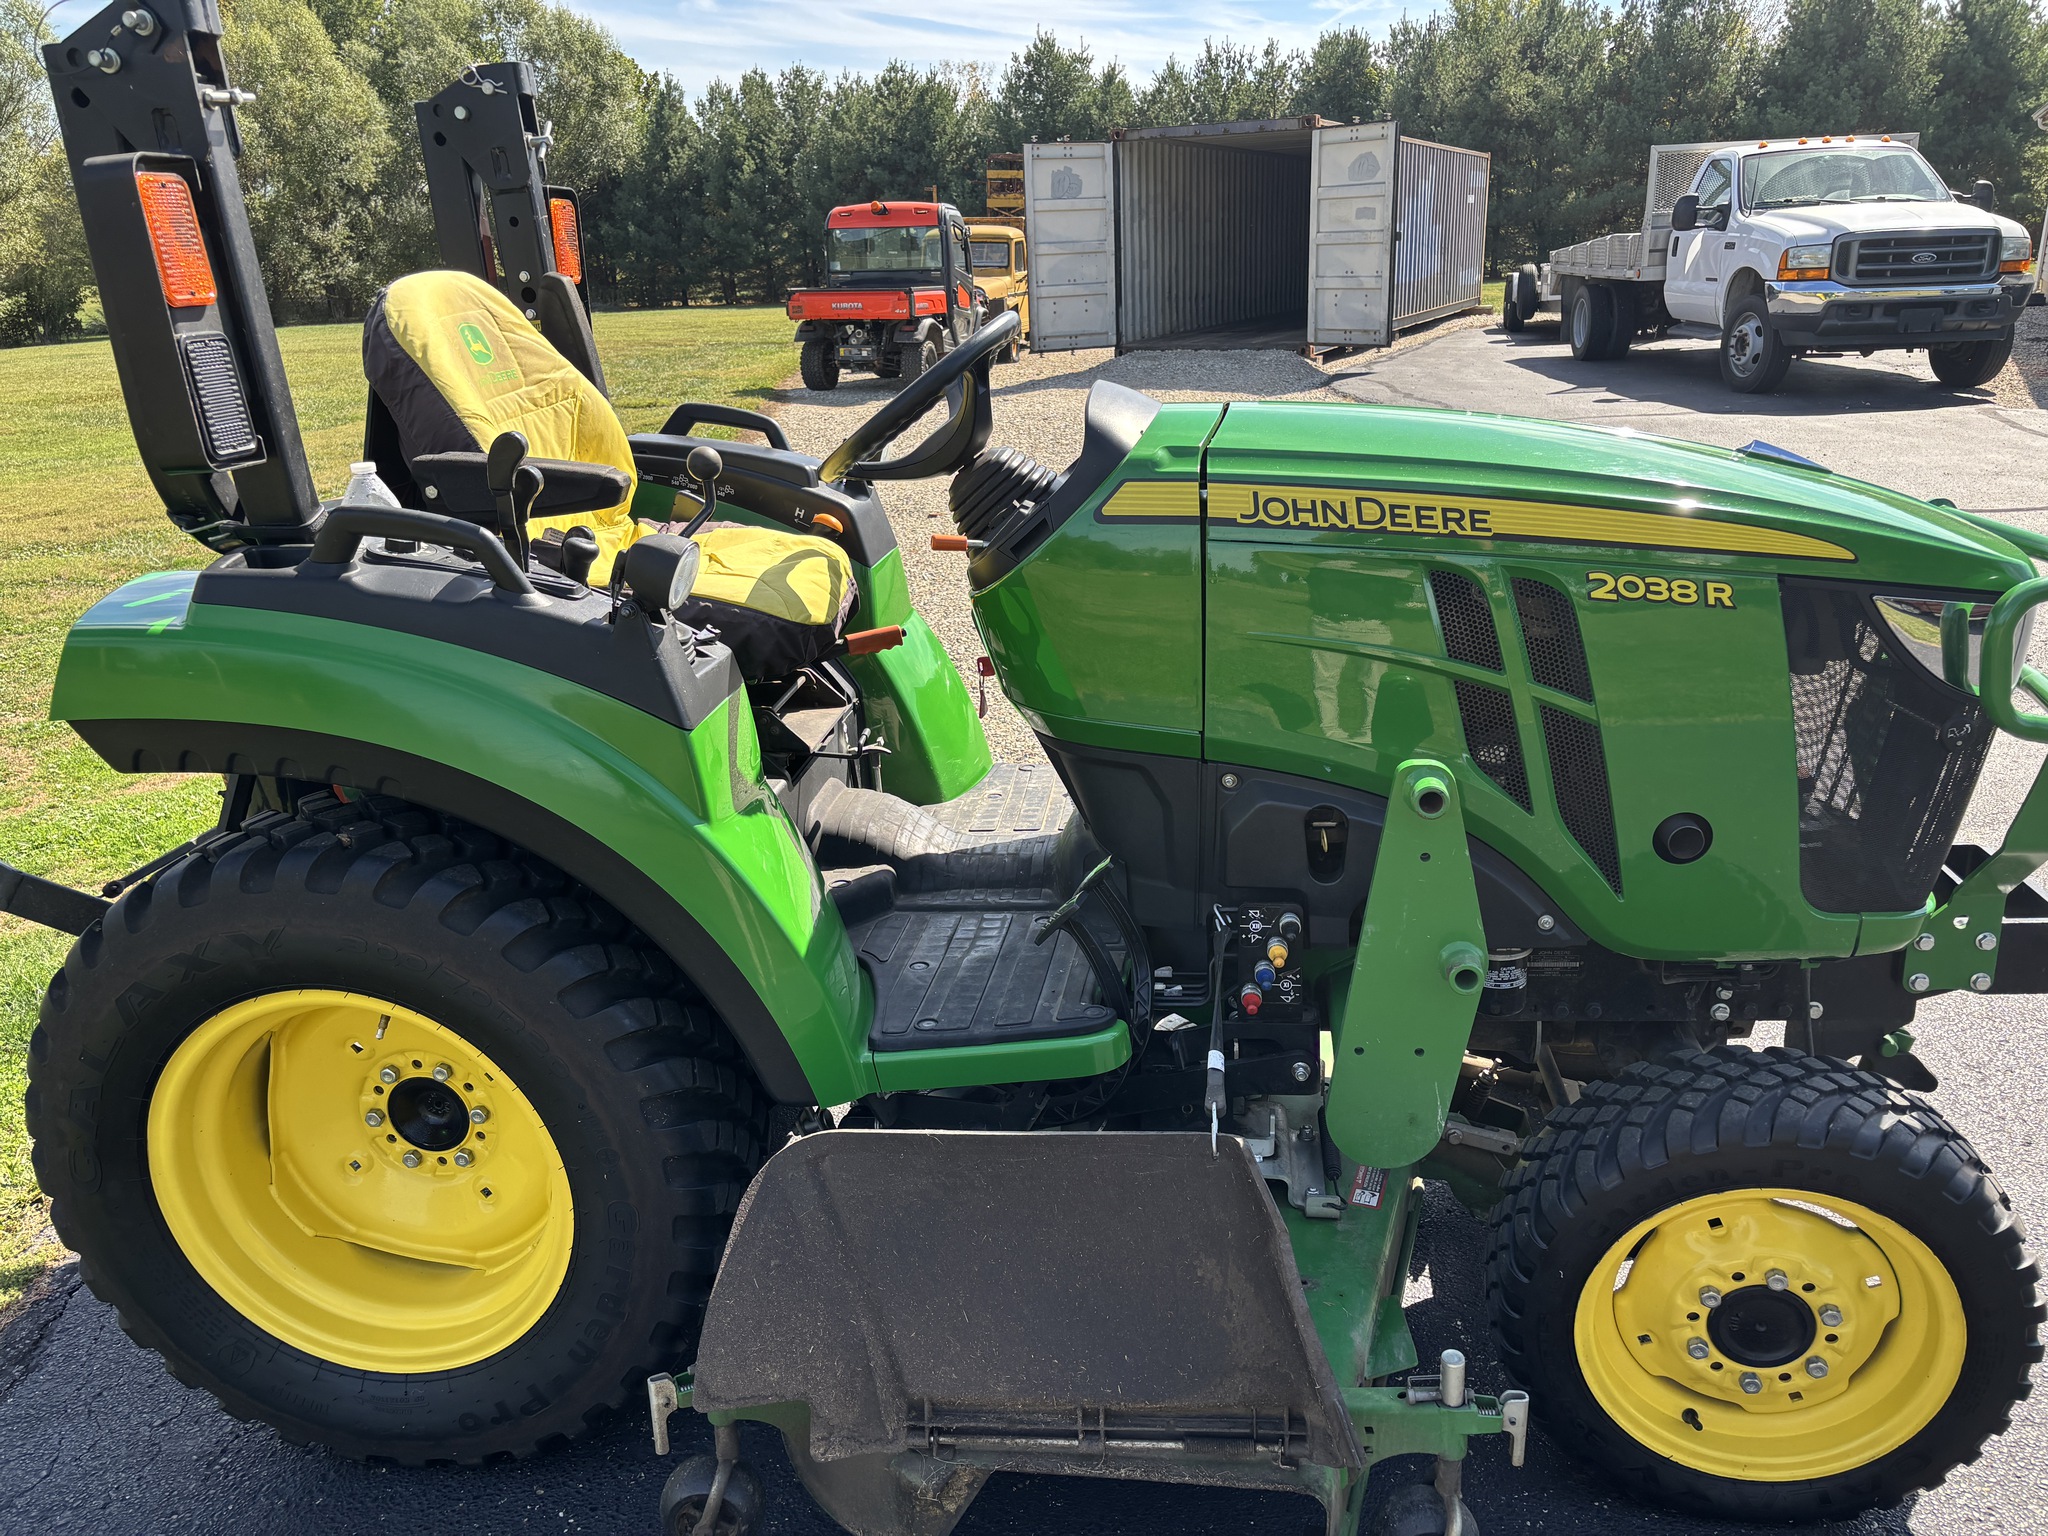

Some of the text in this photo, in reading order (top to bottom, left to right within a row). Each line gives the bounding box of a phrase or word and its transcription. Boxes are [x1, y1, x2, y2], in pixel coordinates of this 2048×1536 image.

[831, 302, 863, 311] KUBOTA
[489, 368, 519, 385] DEERE
[794, 507, 805, 519] H
[1238, 490, 1494, 533] JOHN DEERE
[66, 925, 287, 1194] GALAXY
